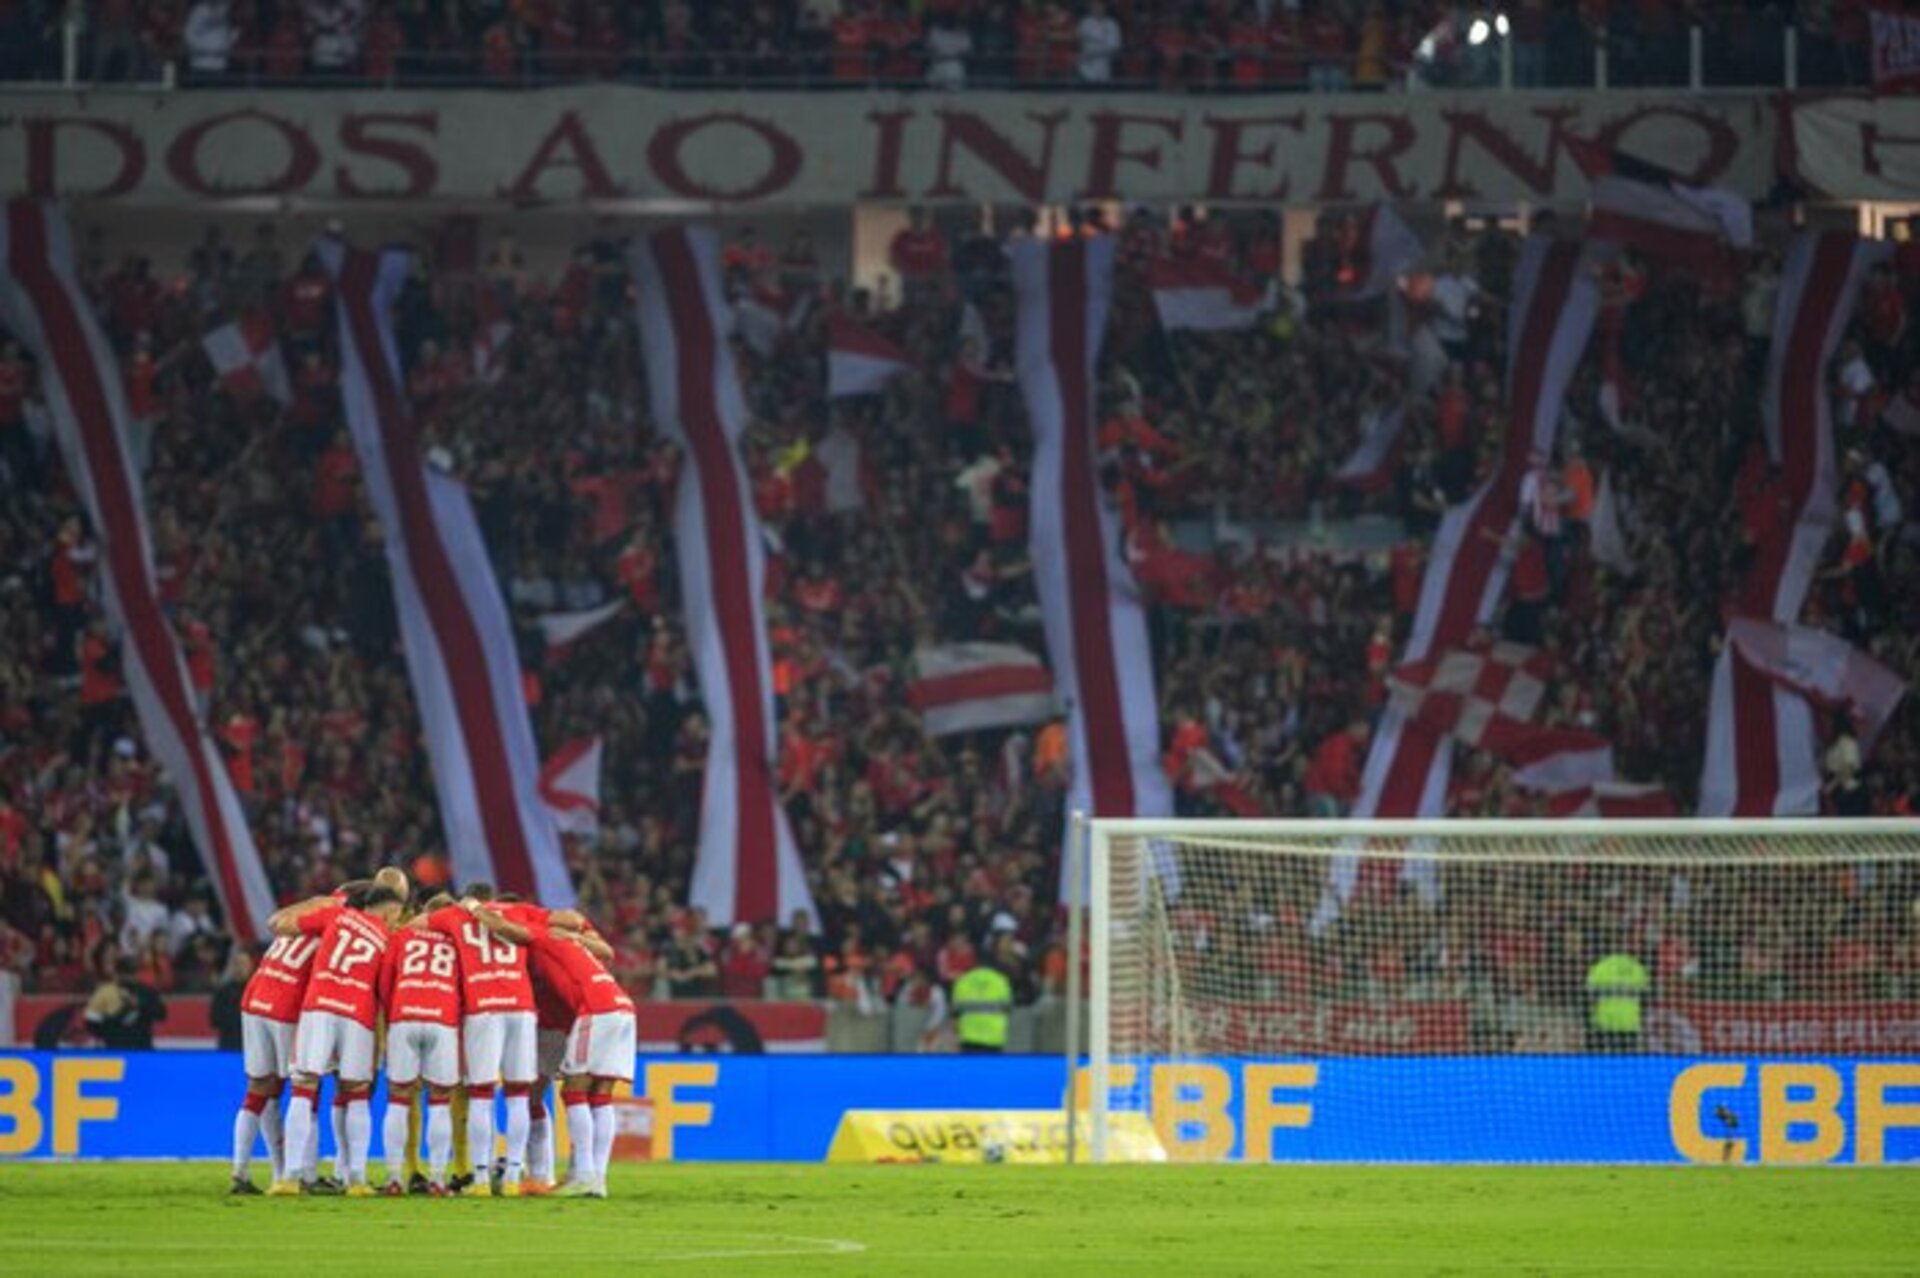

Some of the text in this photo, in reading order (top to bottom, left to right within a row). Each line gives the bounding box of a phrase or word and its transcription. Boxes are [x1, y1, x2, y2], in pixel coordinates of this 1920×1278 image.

[497, 108, 805, 201] AO
[856, 104, 1741, 201] INFERNO
[328, 928, 378, 974] 12
[402, 939, 457, 977] 28
[0, 1058, 125, 1155] BF
[1668, 1063, 1920, 1163] CBF
